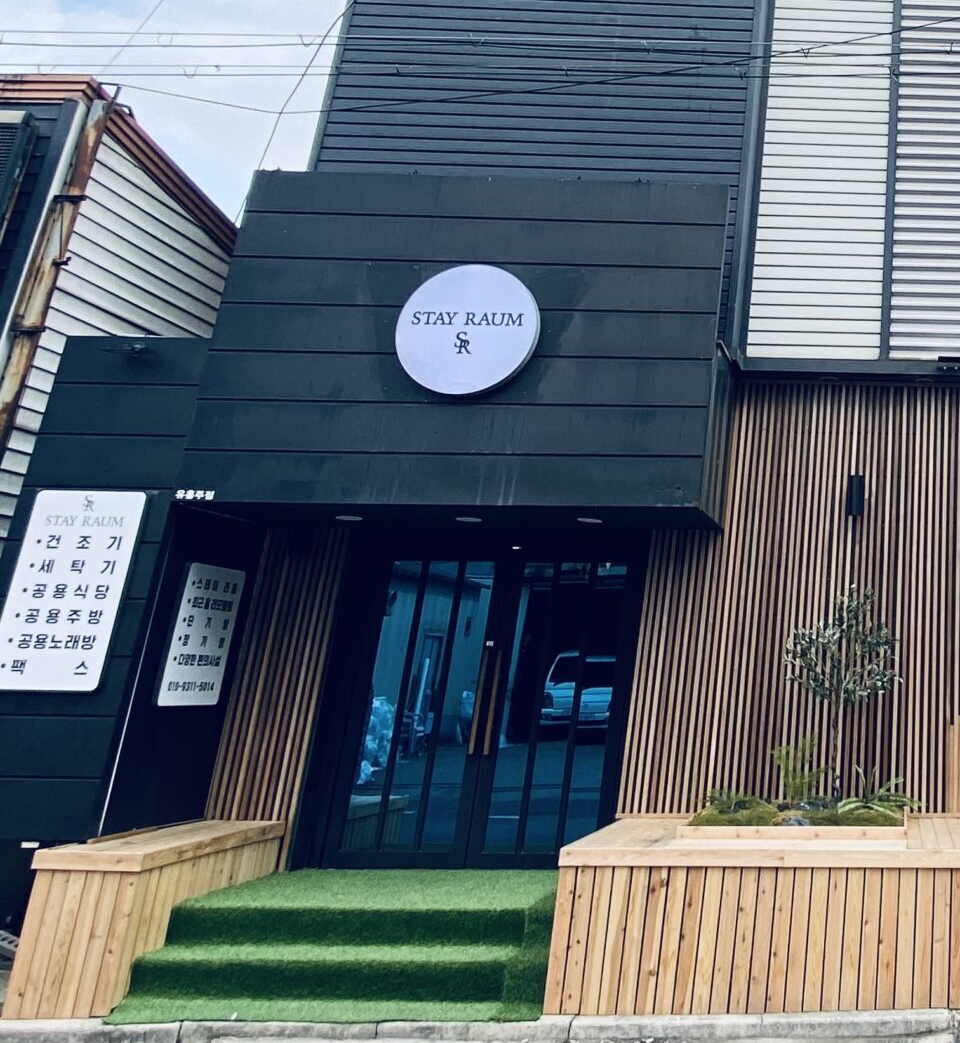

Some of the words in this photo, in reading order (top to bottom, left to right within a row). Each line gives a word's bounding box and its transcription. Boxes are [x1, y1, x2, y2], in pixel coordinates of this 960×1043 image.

[411, 311, 459, 326] STAY
[464, 311, 524, 327] RAUM
[44, 515, 79, 527] STAY
[81, 515, 125, 528] RAUM
[18, 634, 97, 651] 공용노래방
